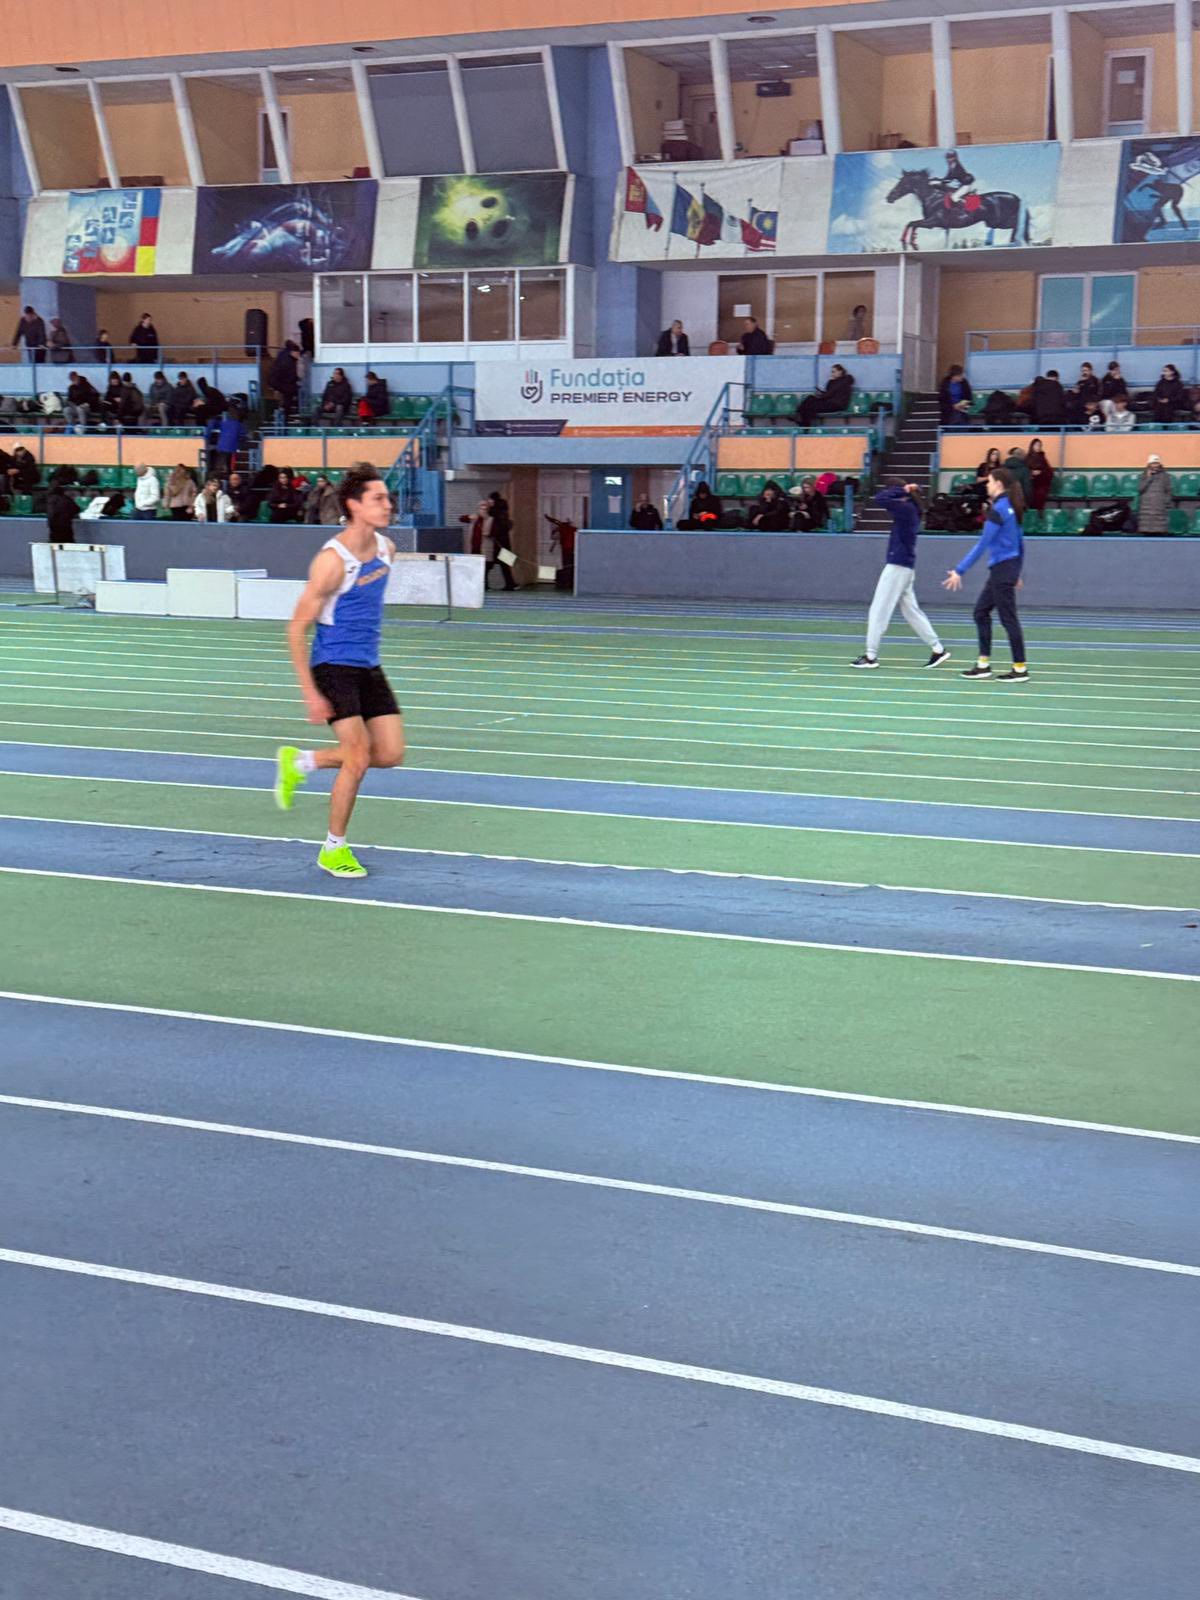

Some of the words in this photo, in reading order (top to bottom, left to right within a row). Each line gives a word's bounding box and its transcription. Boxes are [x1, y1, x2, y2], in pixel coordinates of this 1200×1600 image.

[550, 367, 646, 390] Fundația
[550, 392, 619, 404] PREMIER
[622, 391, 692, 403] ENERGY
